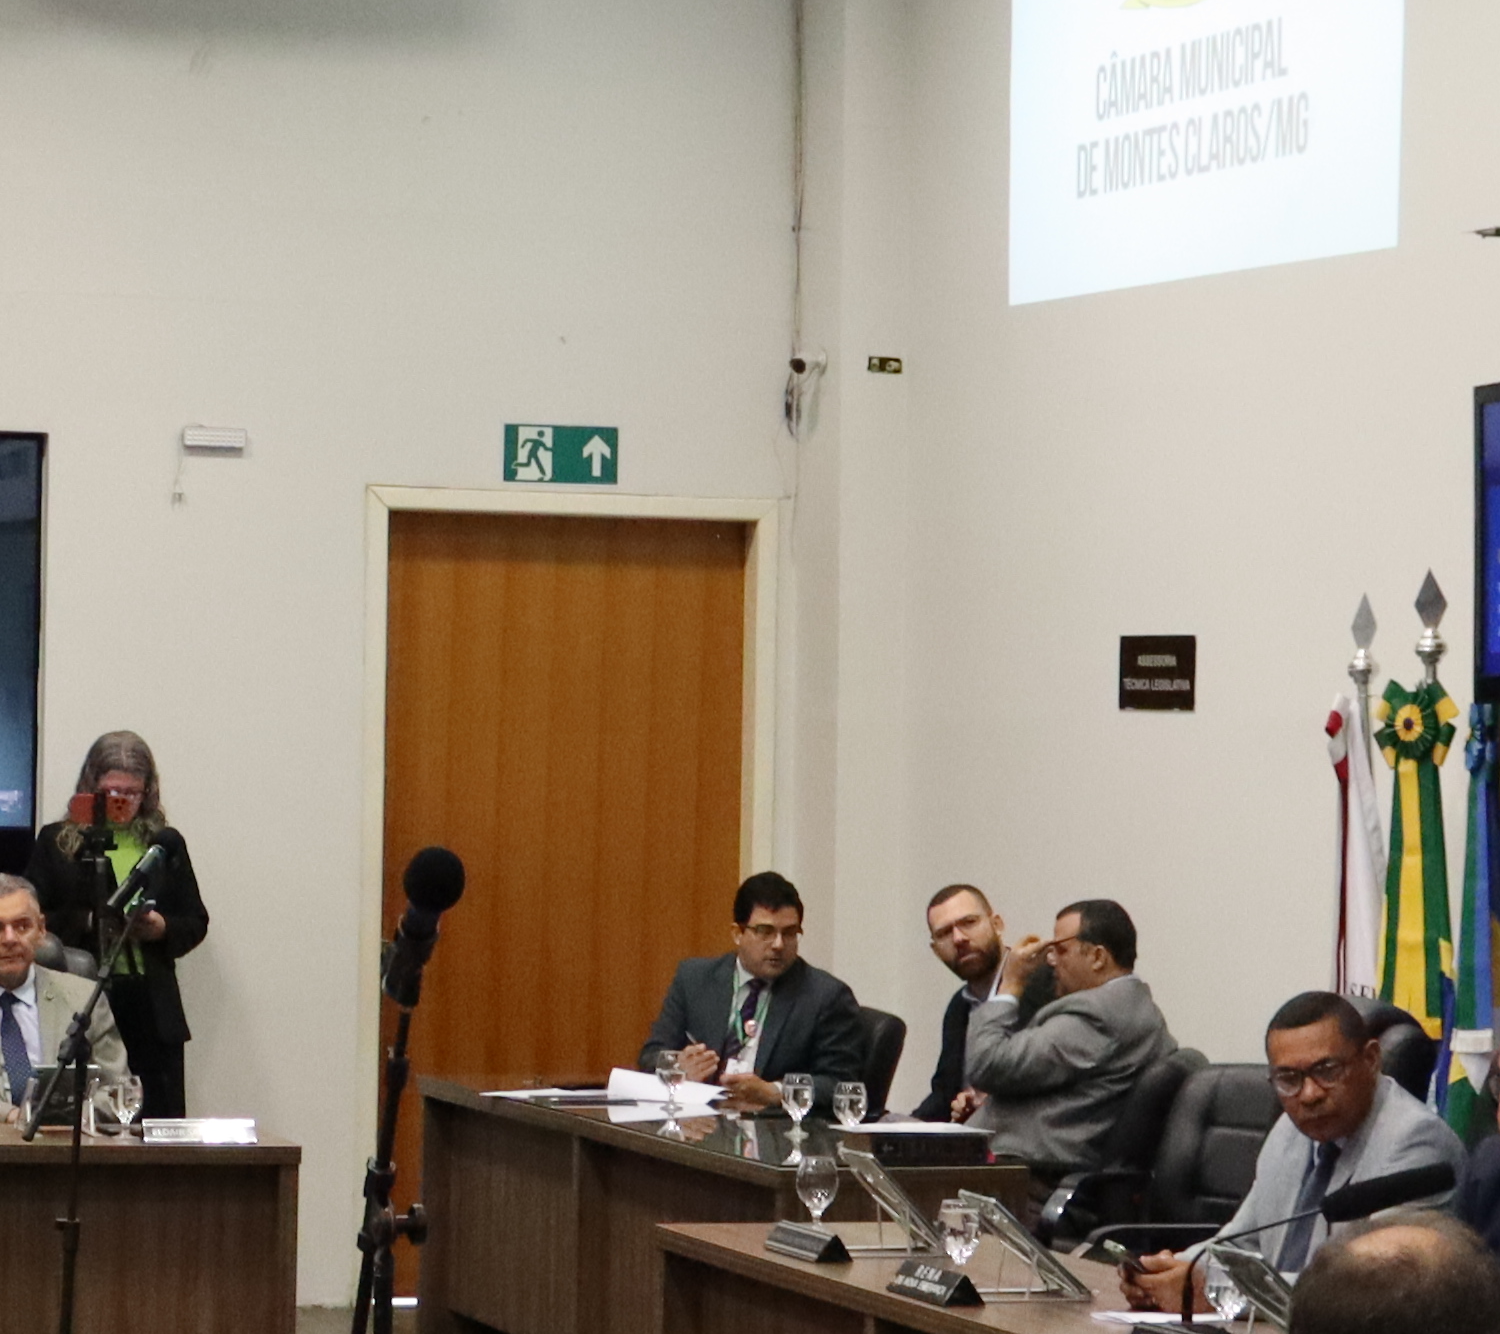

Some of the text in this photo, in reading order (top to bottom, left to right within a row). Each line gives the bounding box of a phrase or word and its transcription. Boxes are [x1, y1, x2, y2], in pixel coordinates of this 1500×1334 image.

[1095, 17, 1288, 121] CÂMARA MUNICIPAL
[1077, 140, 1098, 199] DE
[1104, 120, 1180, 194] MONTES
